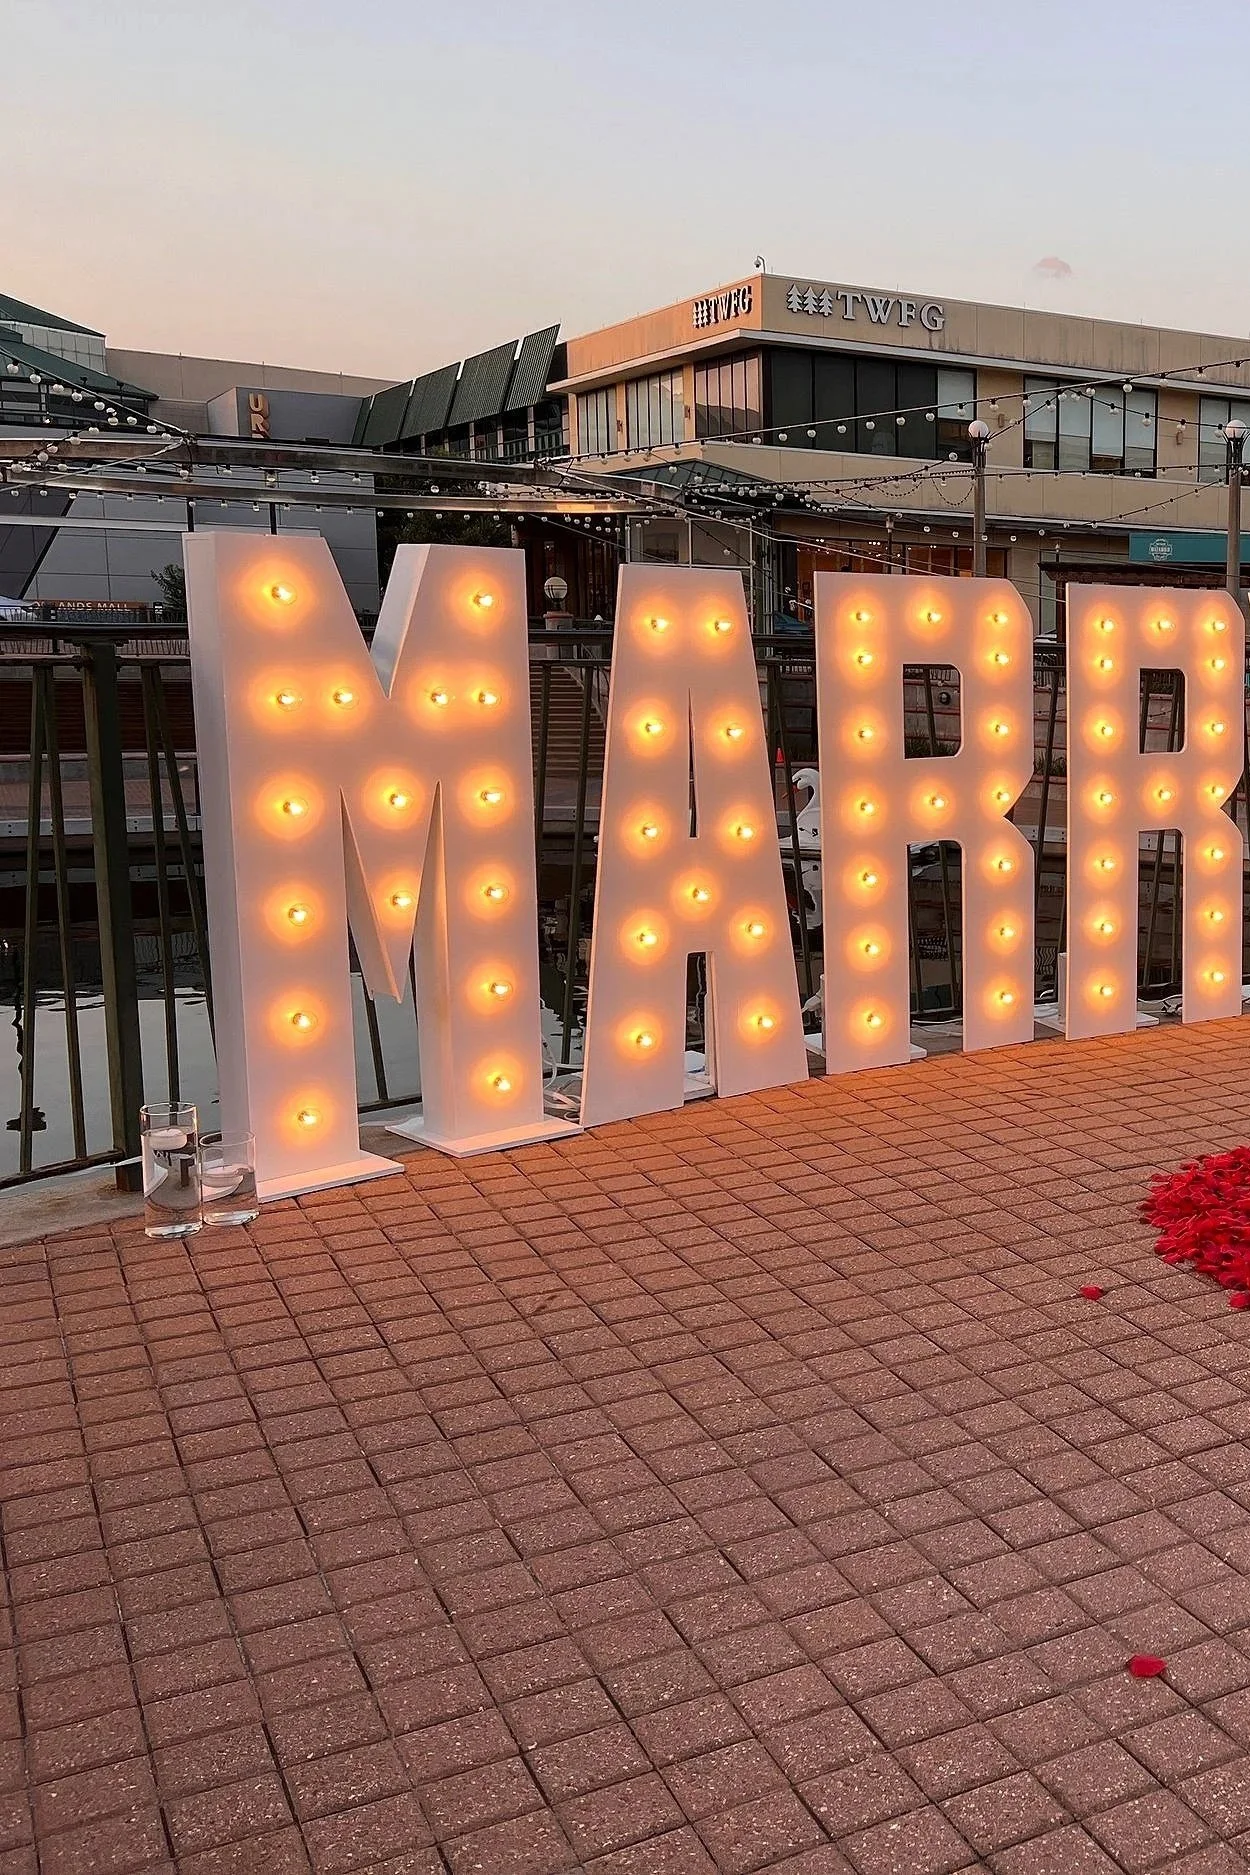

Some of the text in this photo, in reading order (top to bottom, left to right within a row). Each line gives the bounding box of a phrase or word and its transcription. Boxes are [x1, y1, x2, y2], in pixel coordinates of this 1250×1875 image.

[709, 284, 752, 325] TWFG
[837, 290, 946, 332] TWFG
[249, 392, 269, 438] UR
